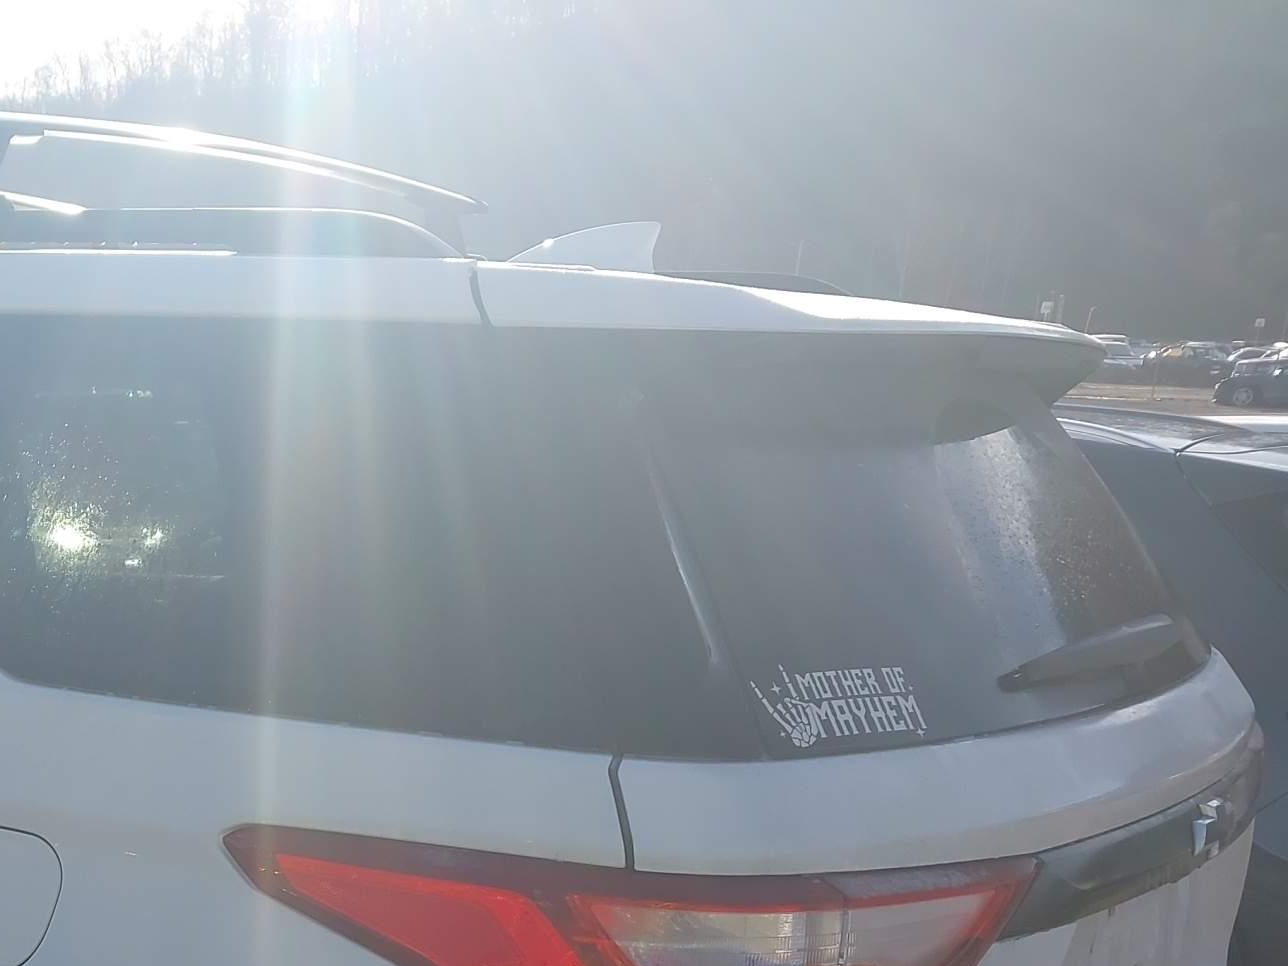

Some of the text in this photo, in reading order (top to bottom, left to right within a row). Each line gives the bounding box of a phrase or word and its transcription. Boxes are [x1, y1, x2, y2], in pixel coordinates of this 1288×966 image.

[796, 667, 906, 699] MOTHER OF
[812, 695, 927, 738] MAYHEM
